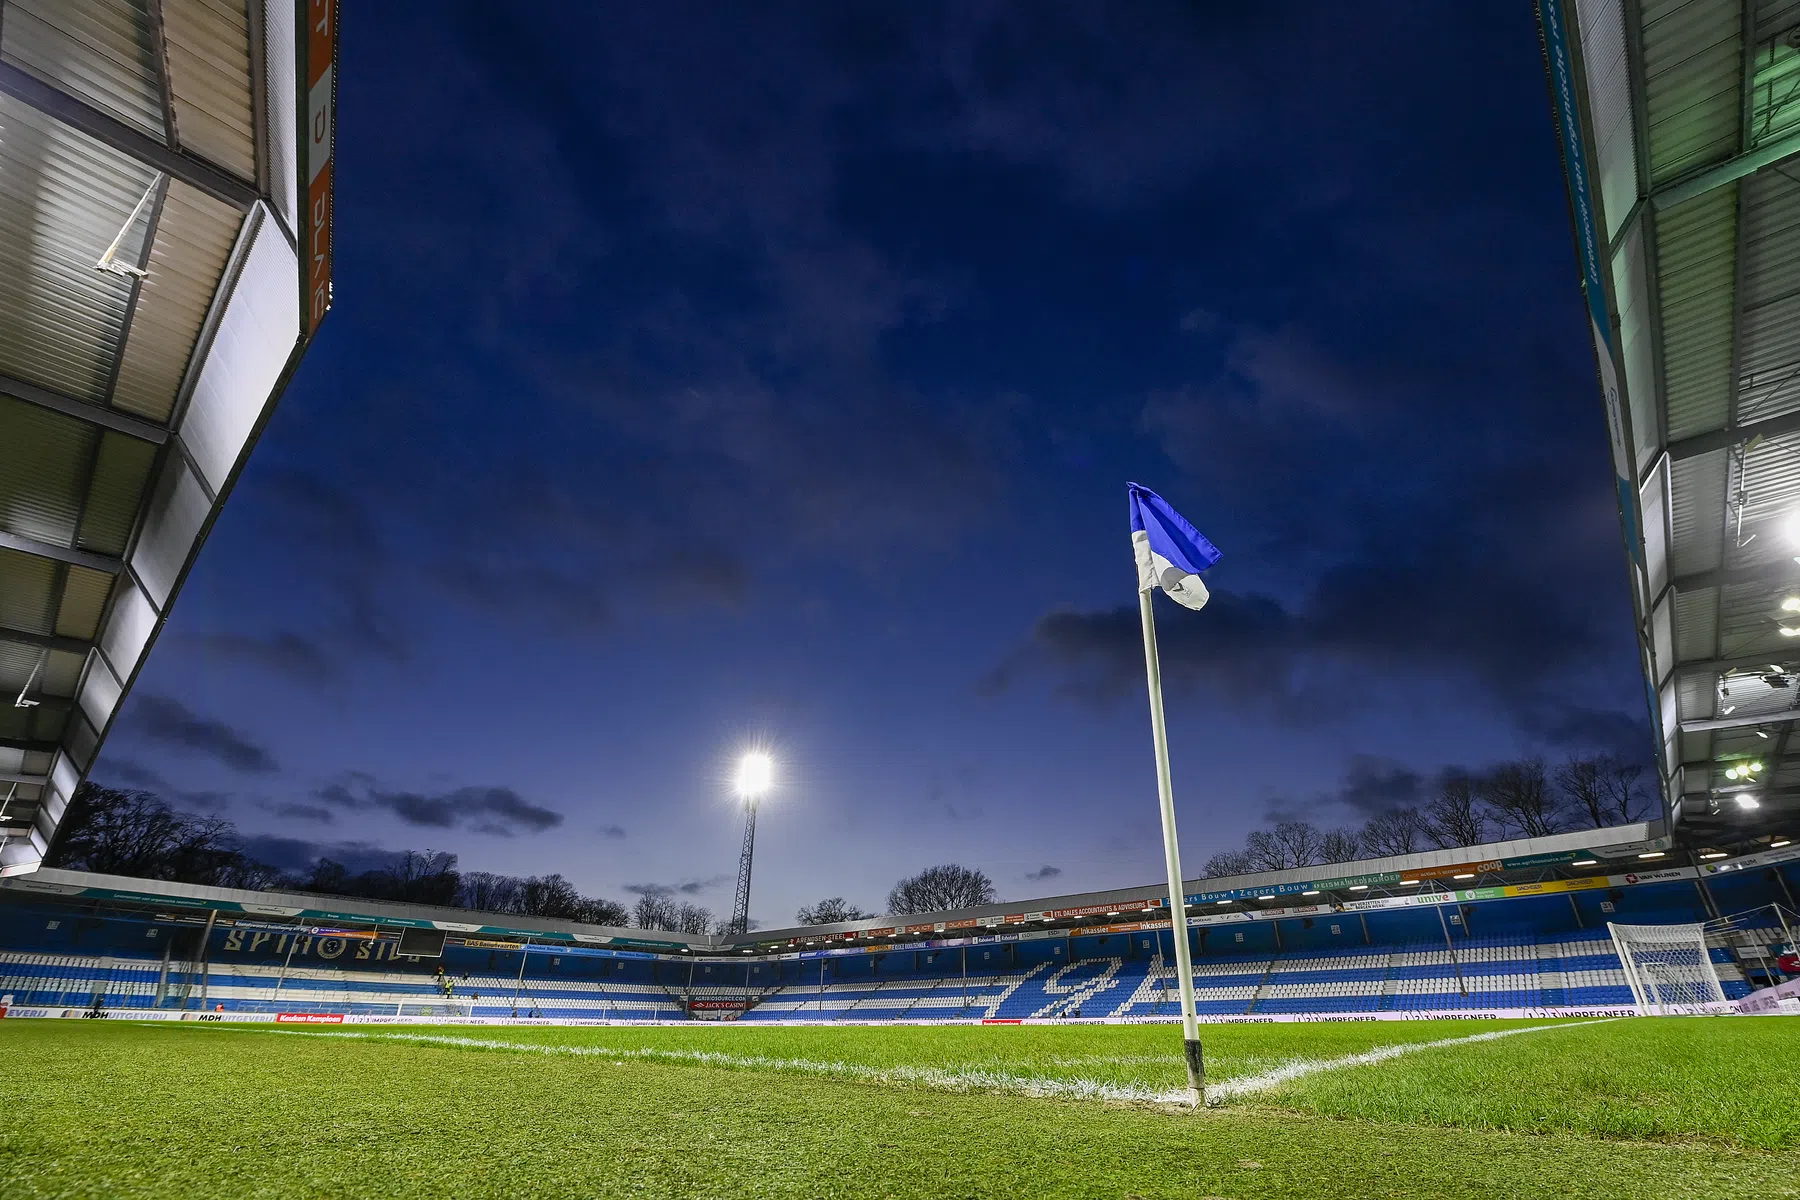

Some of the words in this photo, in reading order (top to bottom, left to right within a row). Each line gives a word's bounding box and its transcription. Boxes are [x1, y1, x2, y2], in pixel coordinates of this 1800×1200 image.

[1555, 45, 1579, 157] organische
[1574, 162, 1584, 192] van
[1579, 196, 1598, 284] Leverancier
[1476, 860, 1503, 873] coop
[1201, 893, 1227, 901] Bouw
[1239, 887, 1275, 897] Zegers
[1279, 884, 1308, 893] Bouw
[1078, 904, 1112, 915] ACCOUNTANTS
[1118, 902, 1146, 911] ADVISEURS
[1080, 926, 1109, 935] Inkassier
[1139, 920, 1172, 930] Inkassier
[279, 1014, 306, 1022] Keuken
[307, 1015, 342, 1023] Kampioen
